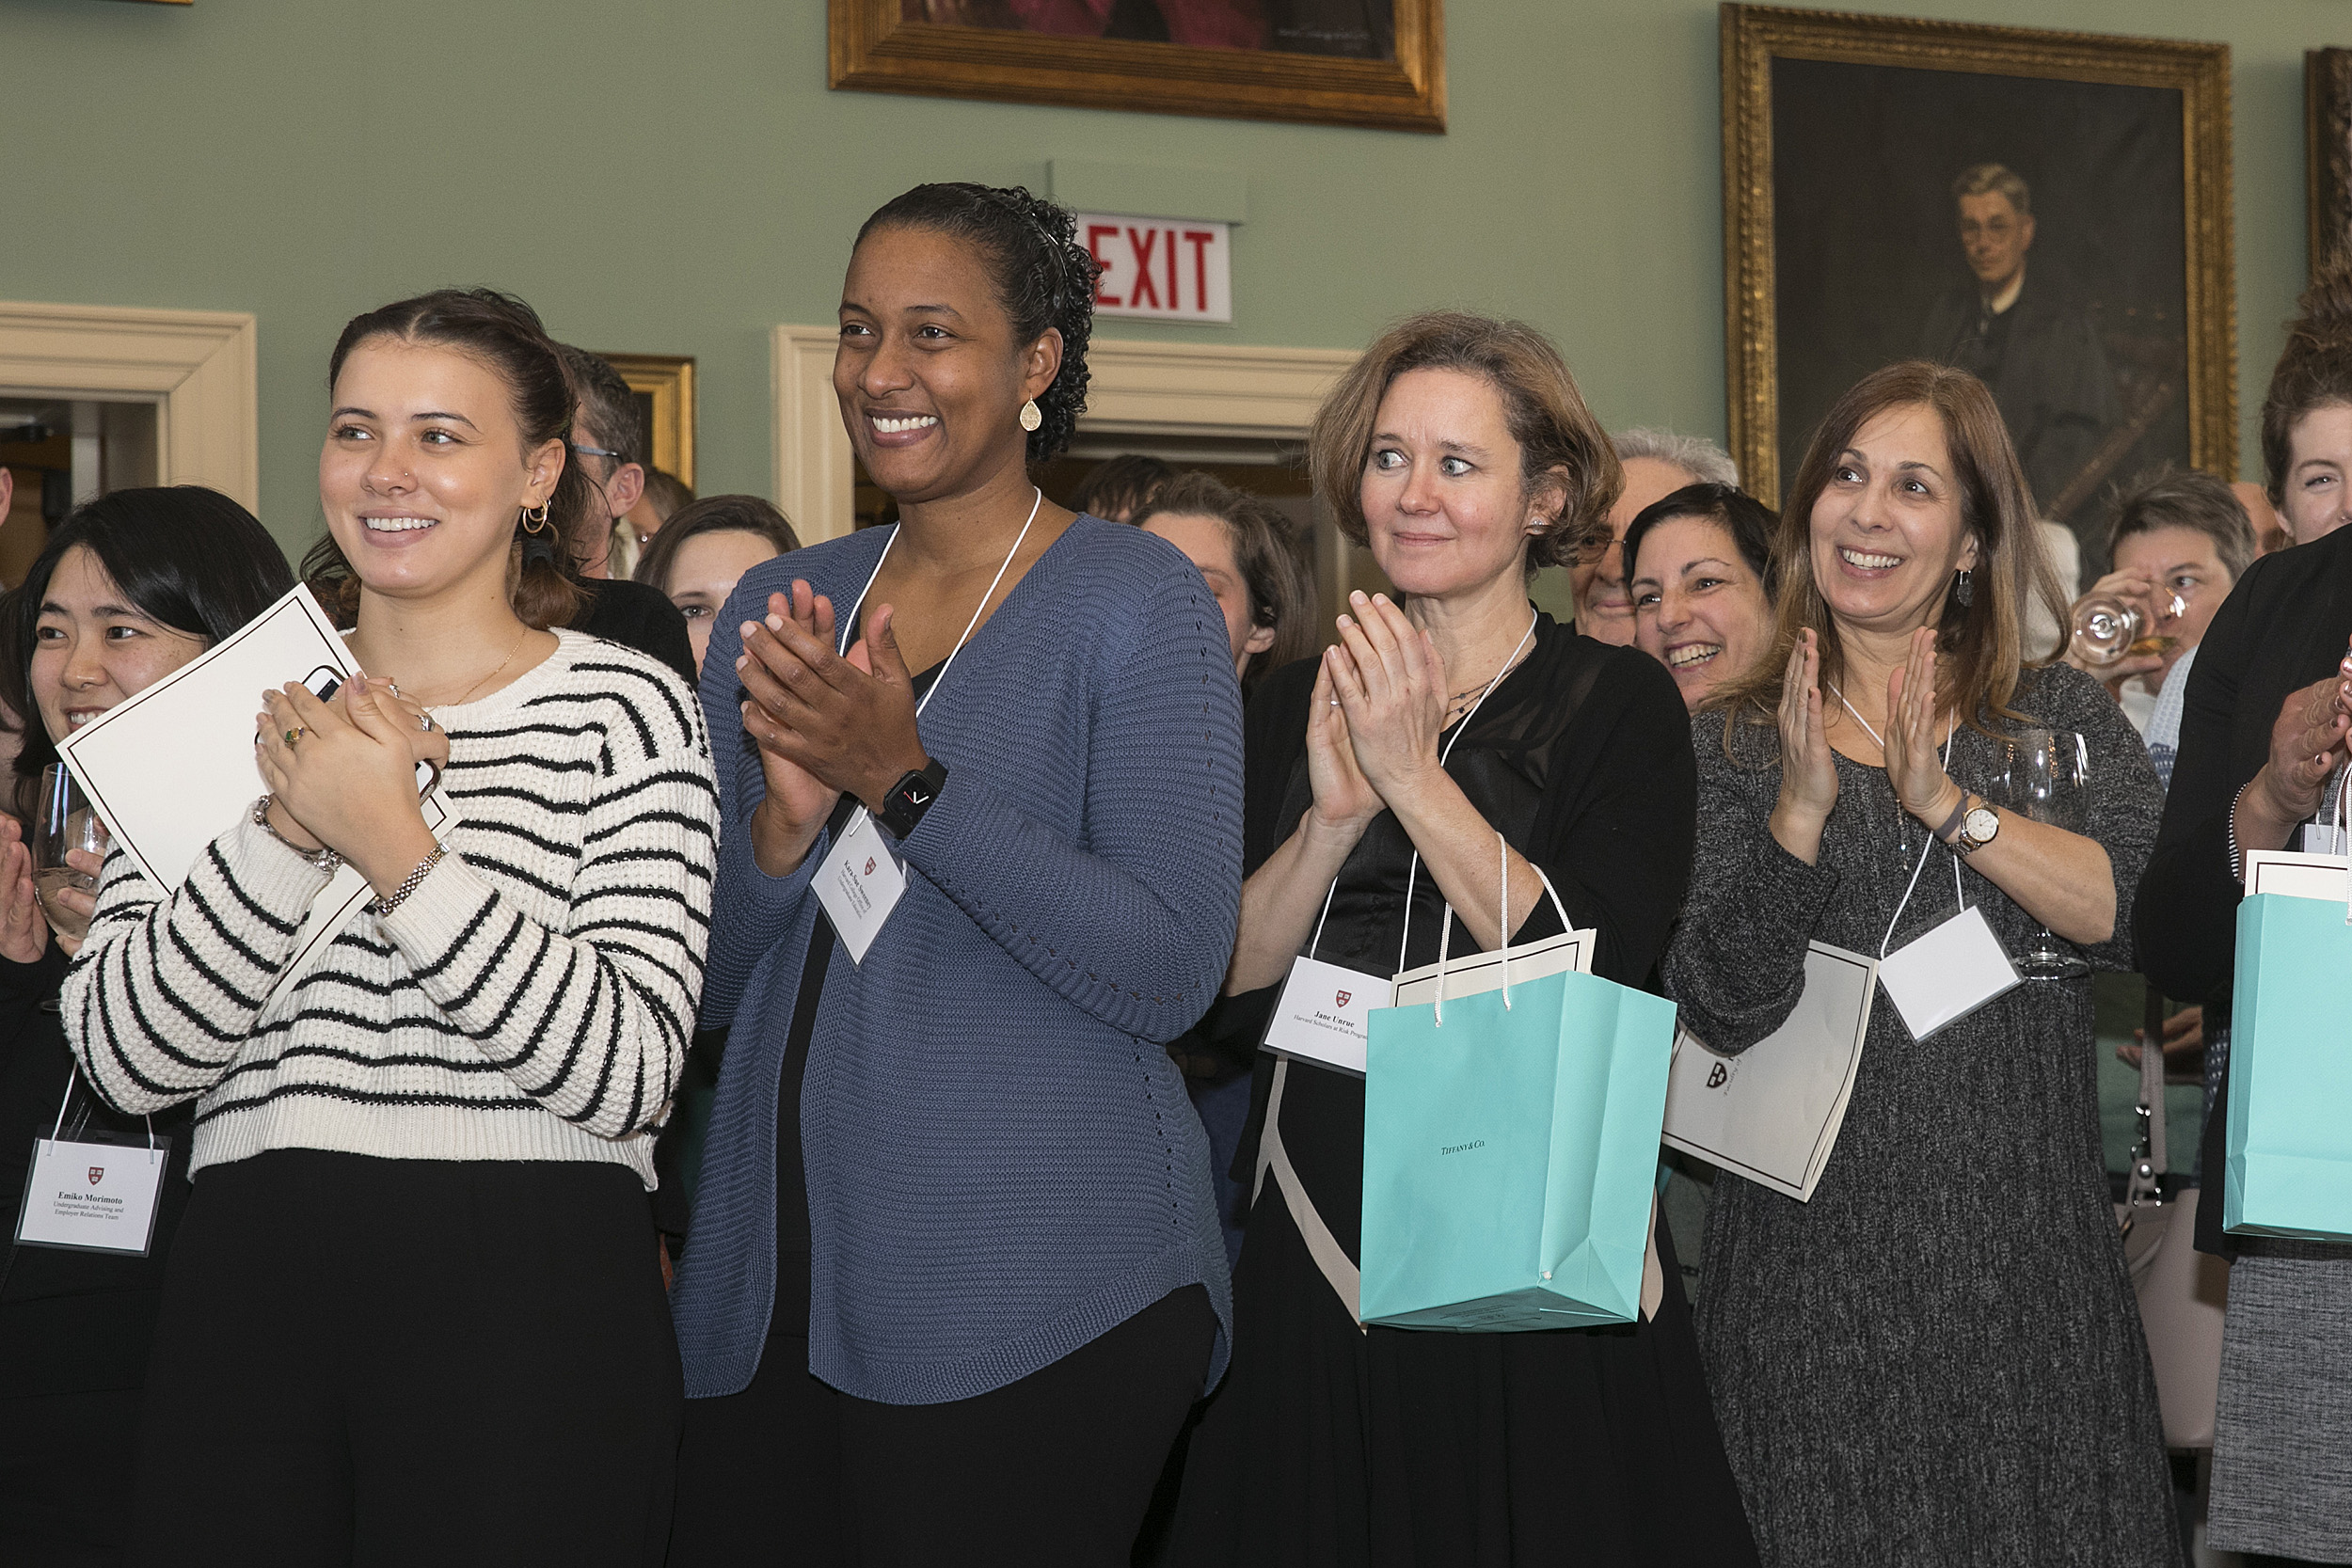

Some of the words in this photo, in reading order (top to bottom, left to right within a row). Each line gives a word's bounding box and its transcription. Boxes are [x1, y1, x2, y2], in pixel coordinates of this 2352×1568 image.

[1088, 225, 1215, 312] EXIT
[1294, 1014, 1314, 1024] Harvard
[1313, 1020, 1333, 1031] Scholars
[1338, 1027, 1350, 1036] Risk
[1350, 1030, 1368, 1039] Progra
[1313, 1010, 1331, 1022] Jane
[1332, 1015, 1355, 1028] Unrue
[57, 1191, 83, 1201] Emiko
[84, 1194, 123, 1205] Morimoto
[53, 1200, 89, 1211] Undergraduate
[90, 1204, 113, 1213] Advising
[55, 1209, 79, 1217] Employer
[79, 1211, 103, 1219] Relations
